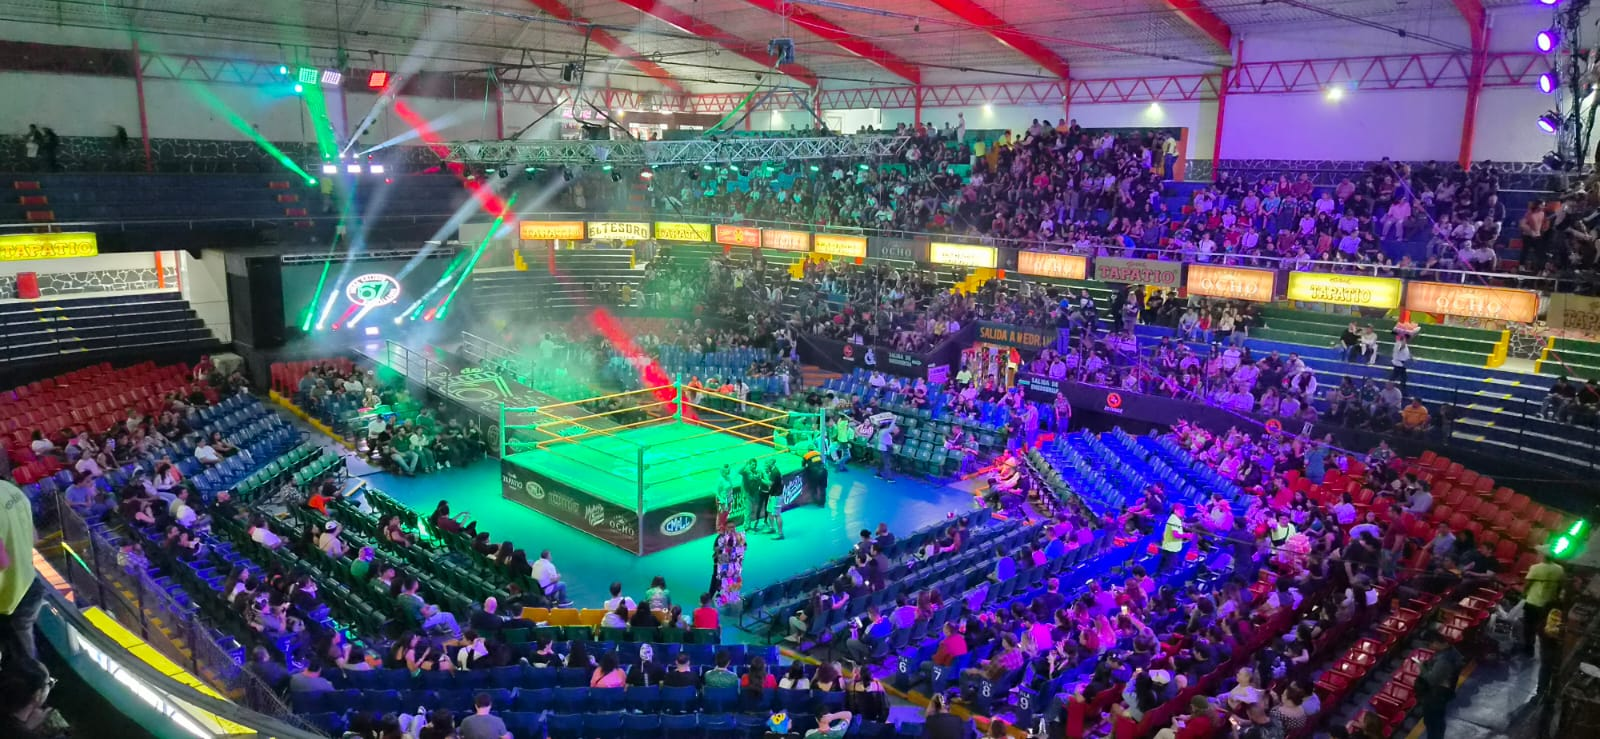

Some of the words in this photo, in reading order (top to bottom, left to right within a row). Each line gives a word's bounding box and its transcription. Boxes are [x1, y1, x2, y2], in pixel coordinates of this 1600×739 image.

[602, 223, 648, 239] TESORO
[1, 242, 93, 258] TAPATIO
[881, 246, 912, 257] OCHO
[1099, 265, 1176, 284] TAPATIO
[358, 280, 390, 300] 67
[1201, 278, 1259, 295] OCHO
[1310, 285, 1372, 303] TAPATIO
[1436, 295, 1501, 314] OCHO
[1563, 309, 1600, 331] TAP
[980, 327, 1007, 341] SALIDA
[1009, 331, 1016, 342] A
[609, 520, 635, 536] OCHO
[899, 661, 907, 673] 6
[934, 670, 941, 680] 7
[982, 686, 991, 697] 8
[1020, 697, 1029, 710] 9
